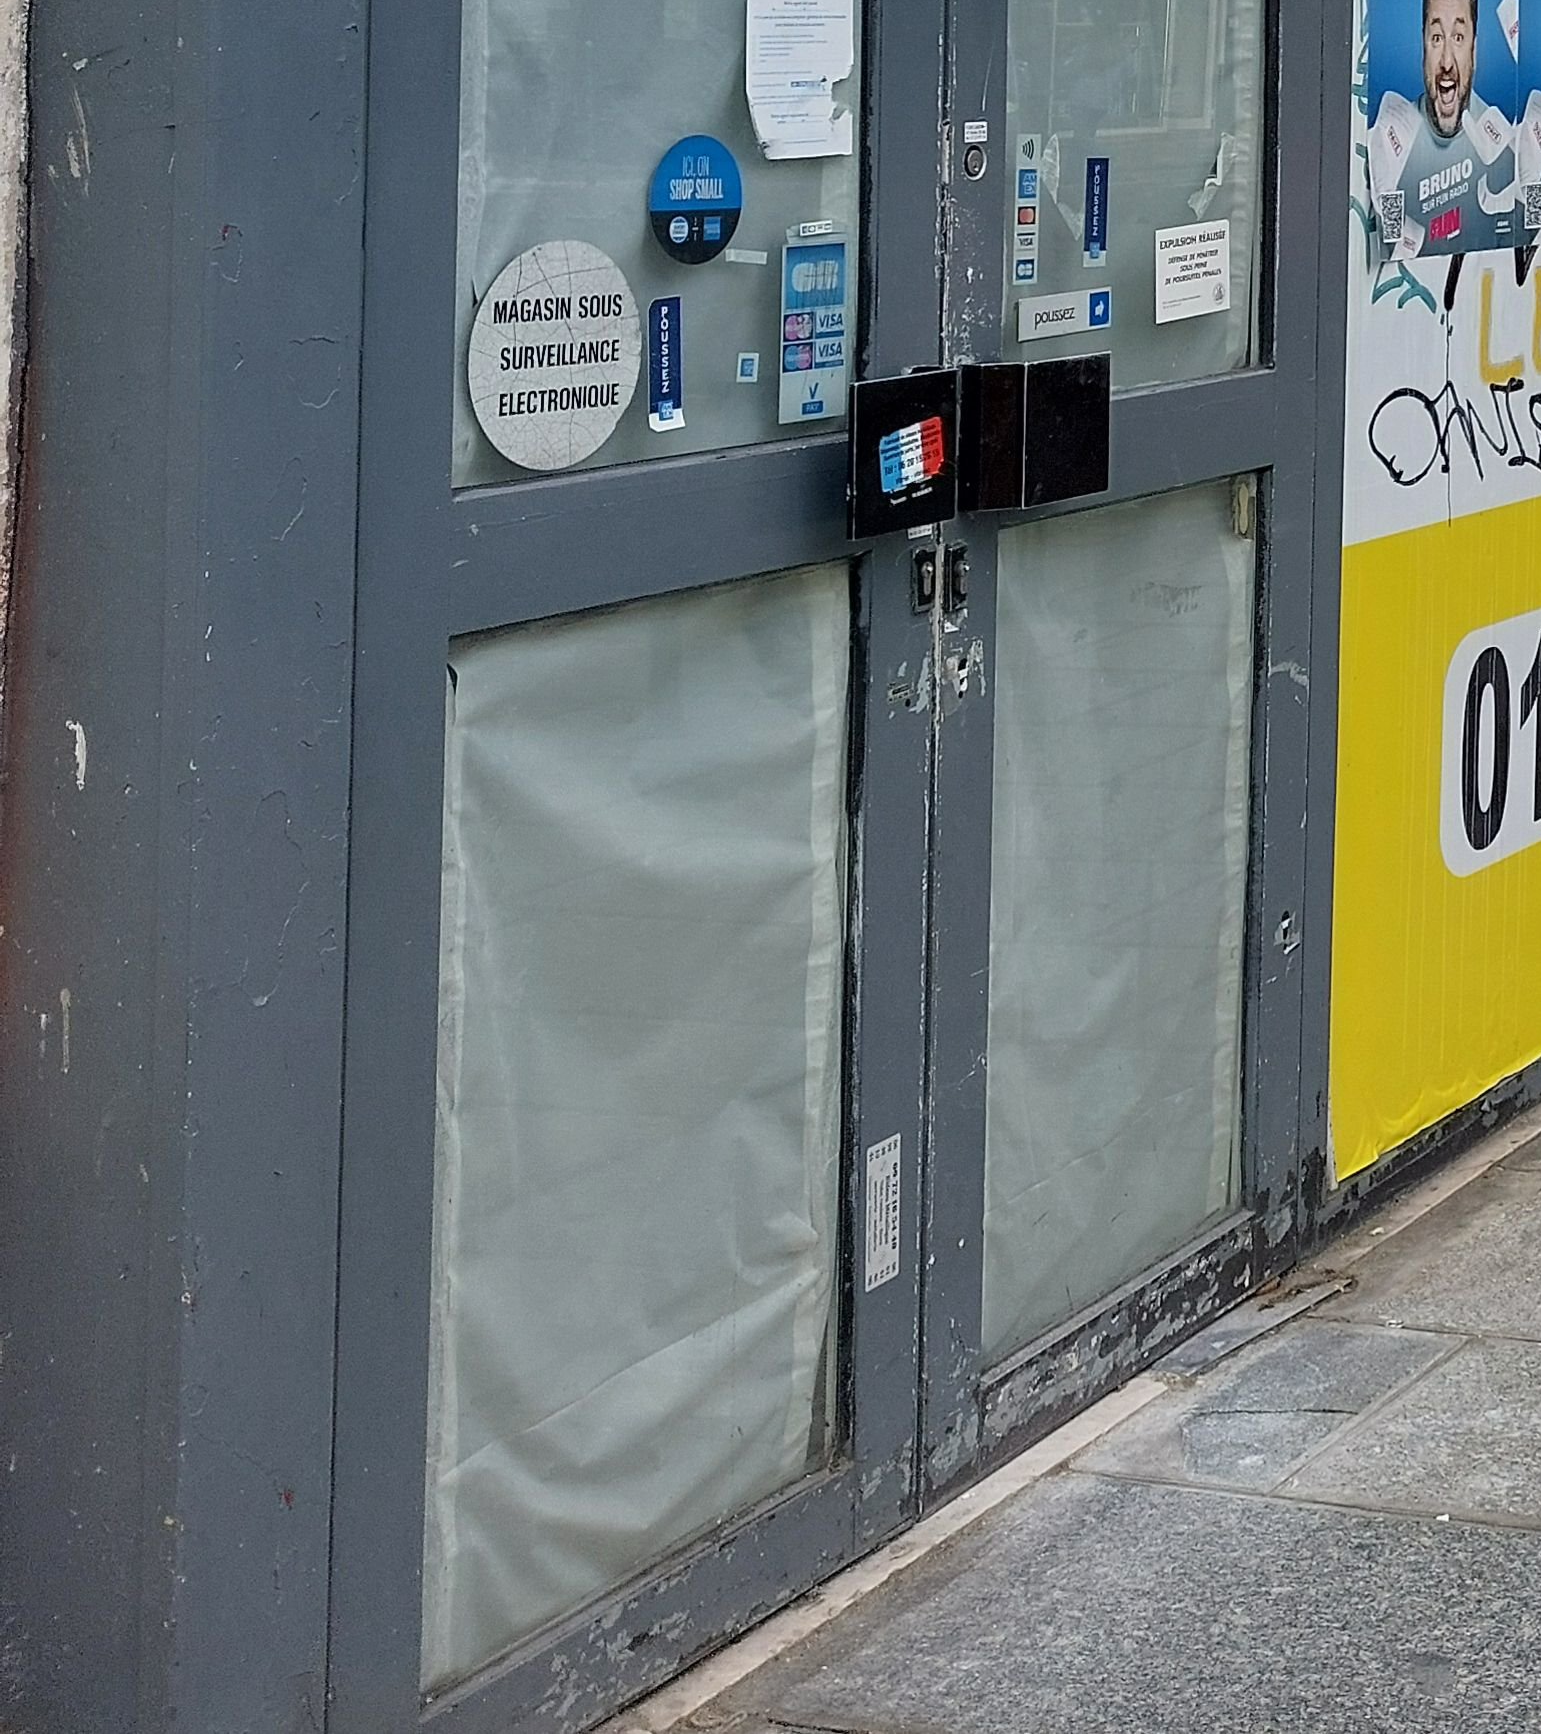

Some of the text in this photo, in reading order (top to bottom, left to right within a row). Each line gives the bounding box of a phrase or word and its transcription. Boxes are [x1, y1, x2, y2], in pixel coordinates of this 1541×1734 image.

[682, 156, 710, 177] ICI, ON
[669, 177, 724, 201] SHOP SMALL
[1418, 158, 1474, 201] BRUNO
[1449, 181, 1470, 204] RADIO
[1019, 237, 1034, 247] VISA
[1160, 235, 1197, 250] EXPULSION
[492, 292, 623, 325] MAGASIN SOUS
[1034, 307, 1076, 330] poussez
[818, 313, 843, 328] VISA
[499, 338, 621, 372] SURVEILLANCE
[660, 306, 670, 394] POUSSEZ
[817, 342, 843, 357] VISA
[498, 382, 620, 418] ELECTRONIQUE
